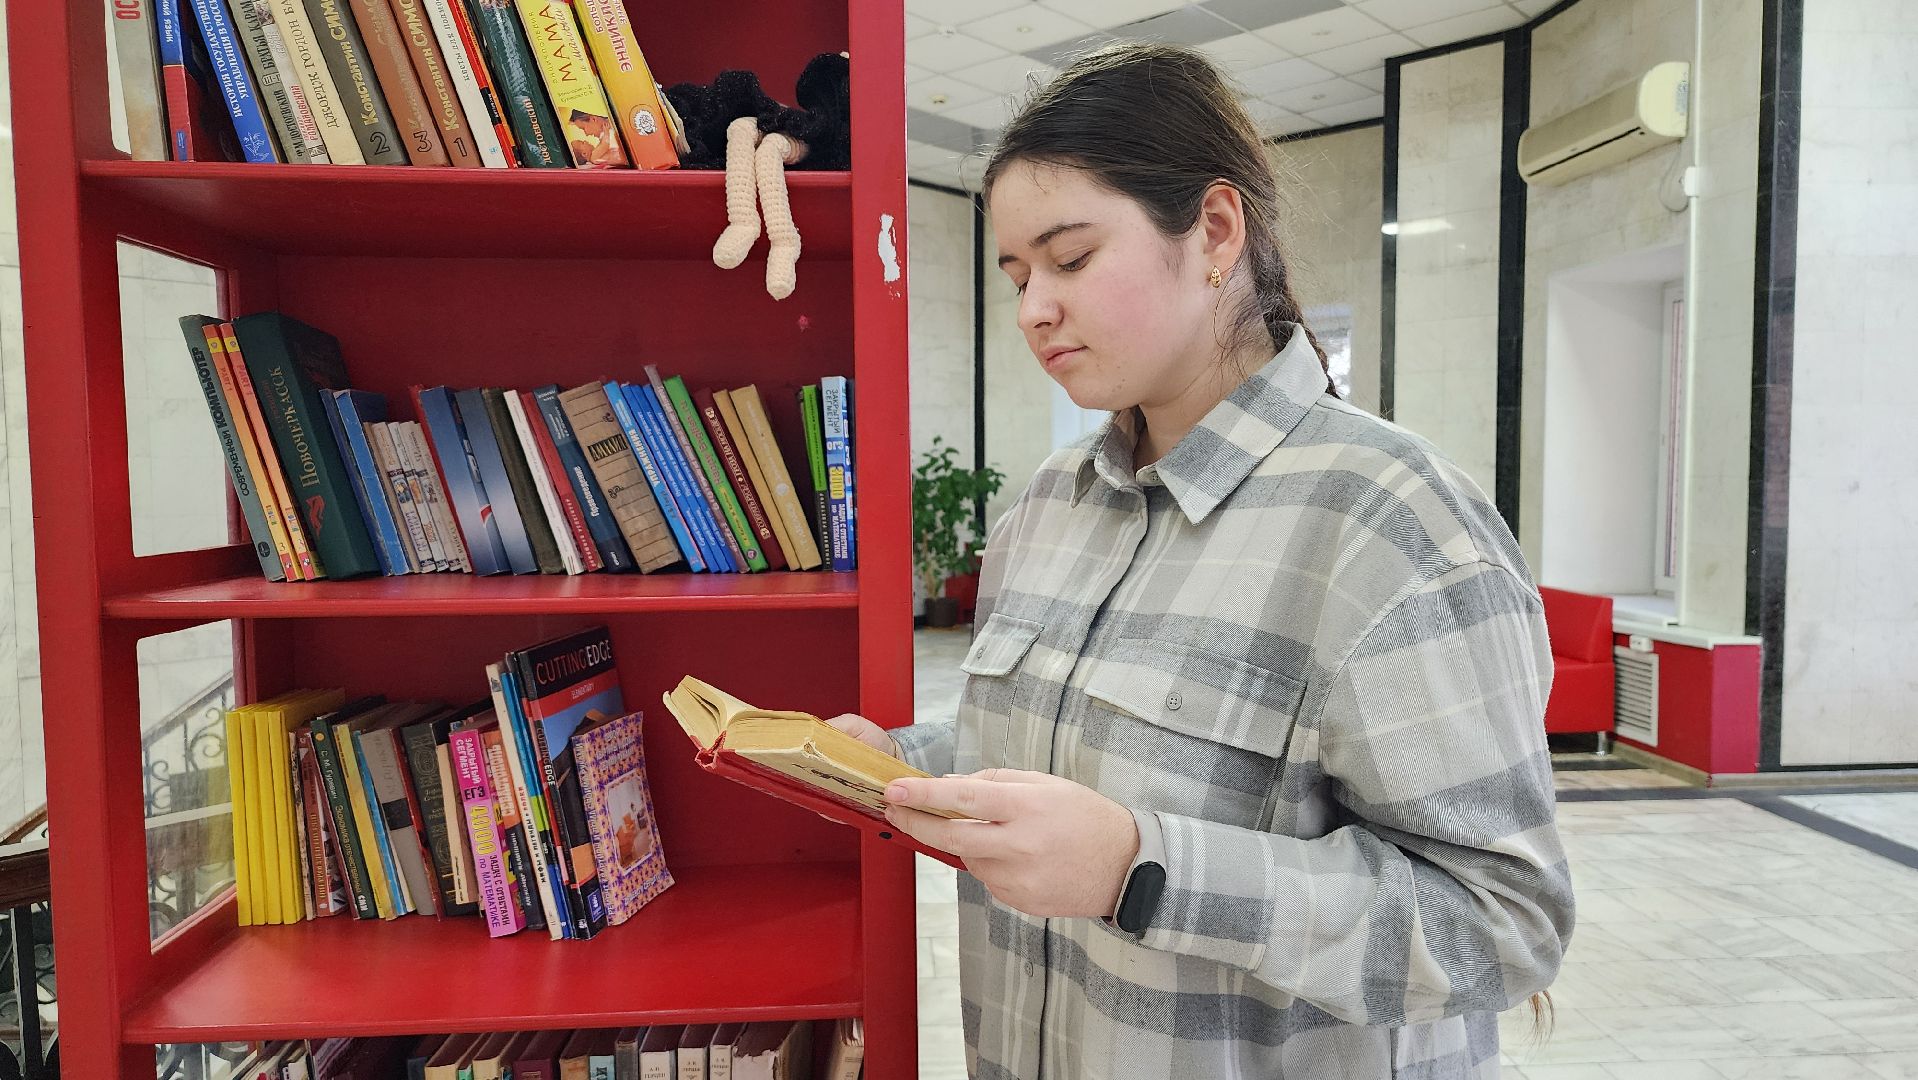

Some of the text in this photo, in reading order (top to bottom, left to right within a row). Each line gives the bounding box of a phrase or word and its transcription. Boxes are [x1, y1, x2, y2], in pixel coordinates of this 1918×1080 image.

[217, 27, 227, 35] В
[253, 34, 274, 70] БРАТЬЯ
[288, 17, 315, 68] ГОРДОН
[539, 6, 577, 82] МАМА
[220, 34, 249, 99] УПРАВЛЕНИЯ
[338, 39, 379, 126] Константин
[220, 72, 243, 118] ИСТОРИЯ
[307, 71, 339, 130] ДЖОРДЖ
[422, 47, 459, 131] Константин
[272, 88, 302, 141] ДОСТОЕВСКИЙ
[289, 84, 318, 141] РОМАНОВСКИЙ
[522, 97, 552, 164] ДОСТОЕВСКИЙ
[370, 132, 391, 155] 2
[413, 131, 433, 153] 3
[454, 138, 468, 157] 1
[220, 366, 230, 385] PART
[236, 363, 249, 387] PART
[192, 346, 250, 497] СОВРЕМЕННЫЙ КОМПЬЮТЕР
[825, 389, 834, 427] СЕГМЕНТ
[832, 390, 842, 434] ЗАКРЫТЫЙ
[627, 428, 661, 487] УПРАЖНЕНИЯ
[831, 515, 840, 557] МАТЕМАТИКЕ
[839, 528, 847, 558] ОТВЕТАМИ
[454, 738, 471, 779] СЕГМЕНТ
[463, 737, 481, 784] ЗАКРЫТЫЙ
[323, 769, 339, 799] Гуревич
[464, 786, 486, 800] ЕГЭ
[334, 804, 351, 843] Экономика
[357, 894, 368, 911] СМИ
[488, 854, 501, 878] ЗАДАЧ
[480, 870, 501, 928] МАТЕМАТИКЕ
[494, 886, 511, 925] ОТВЕТАМИ
